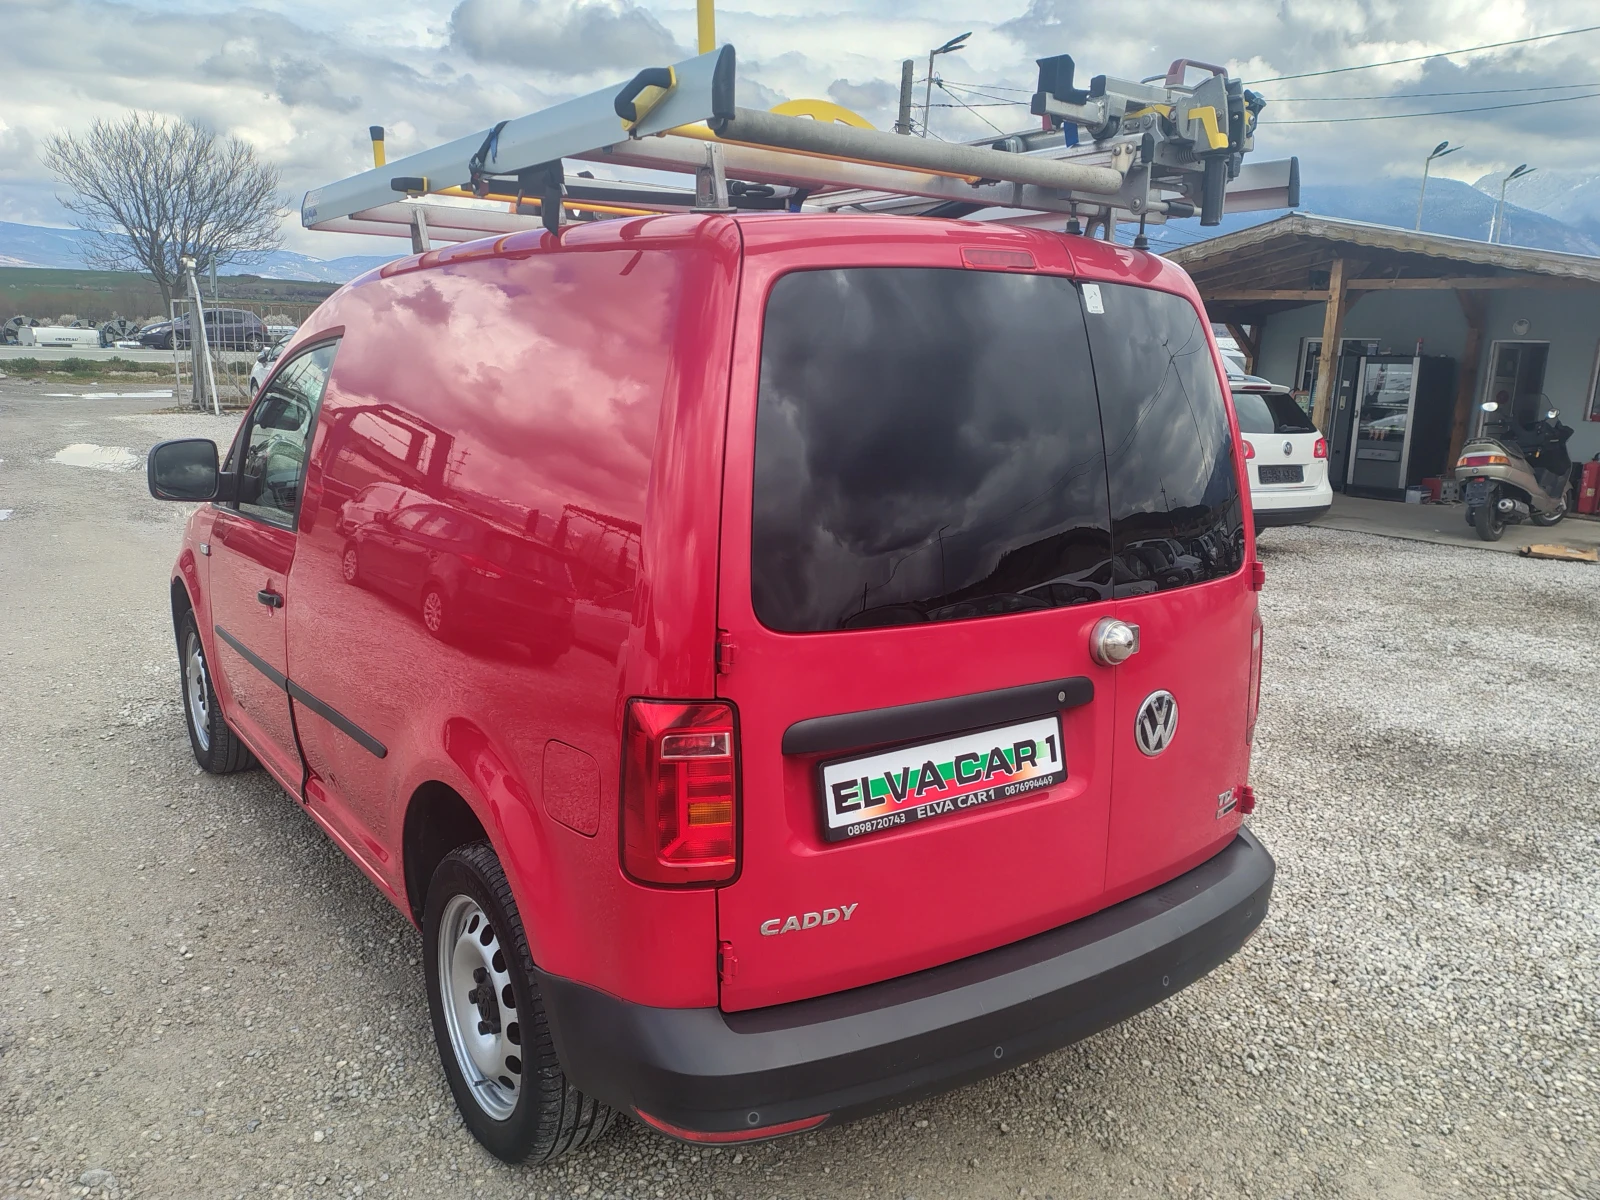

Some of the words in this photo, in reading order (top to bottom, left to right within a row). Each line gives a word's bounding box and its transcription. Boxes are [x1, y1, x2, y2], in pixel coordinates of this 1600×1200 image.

[831, 760, 947, 815] ELVA
[954, 739, 1038, 785] CAR
[1045, 734, 1057, 763] 1
[1004, 775, 1053, 796] 0876994449
[917, 801, 954, 819] ELVA
[847, 813, 905, 836] 0898720743
[760, 902, 858, 936] CADDY
